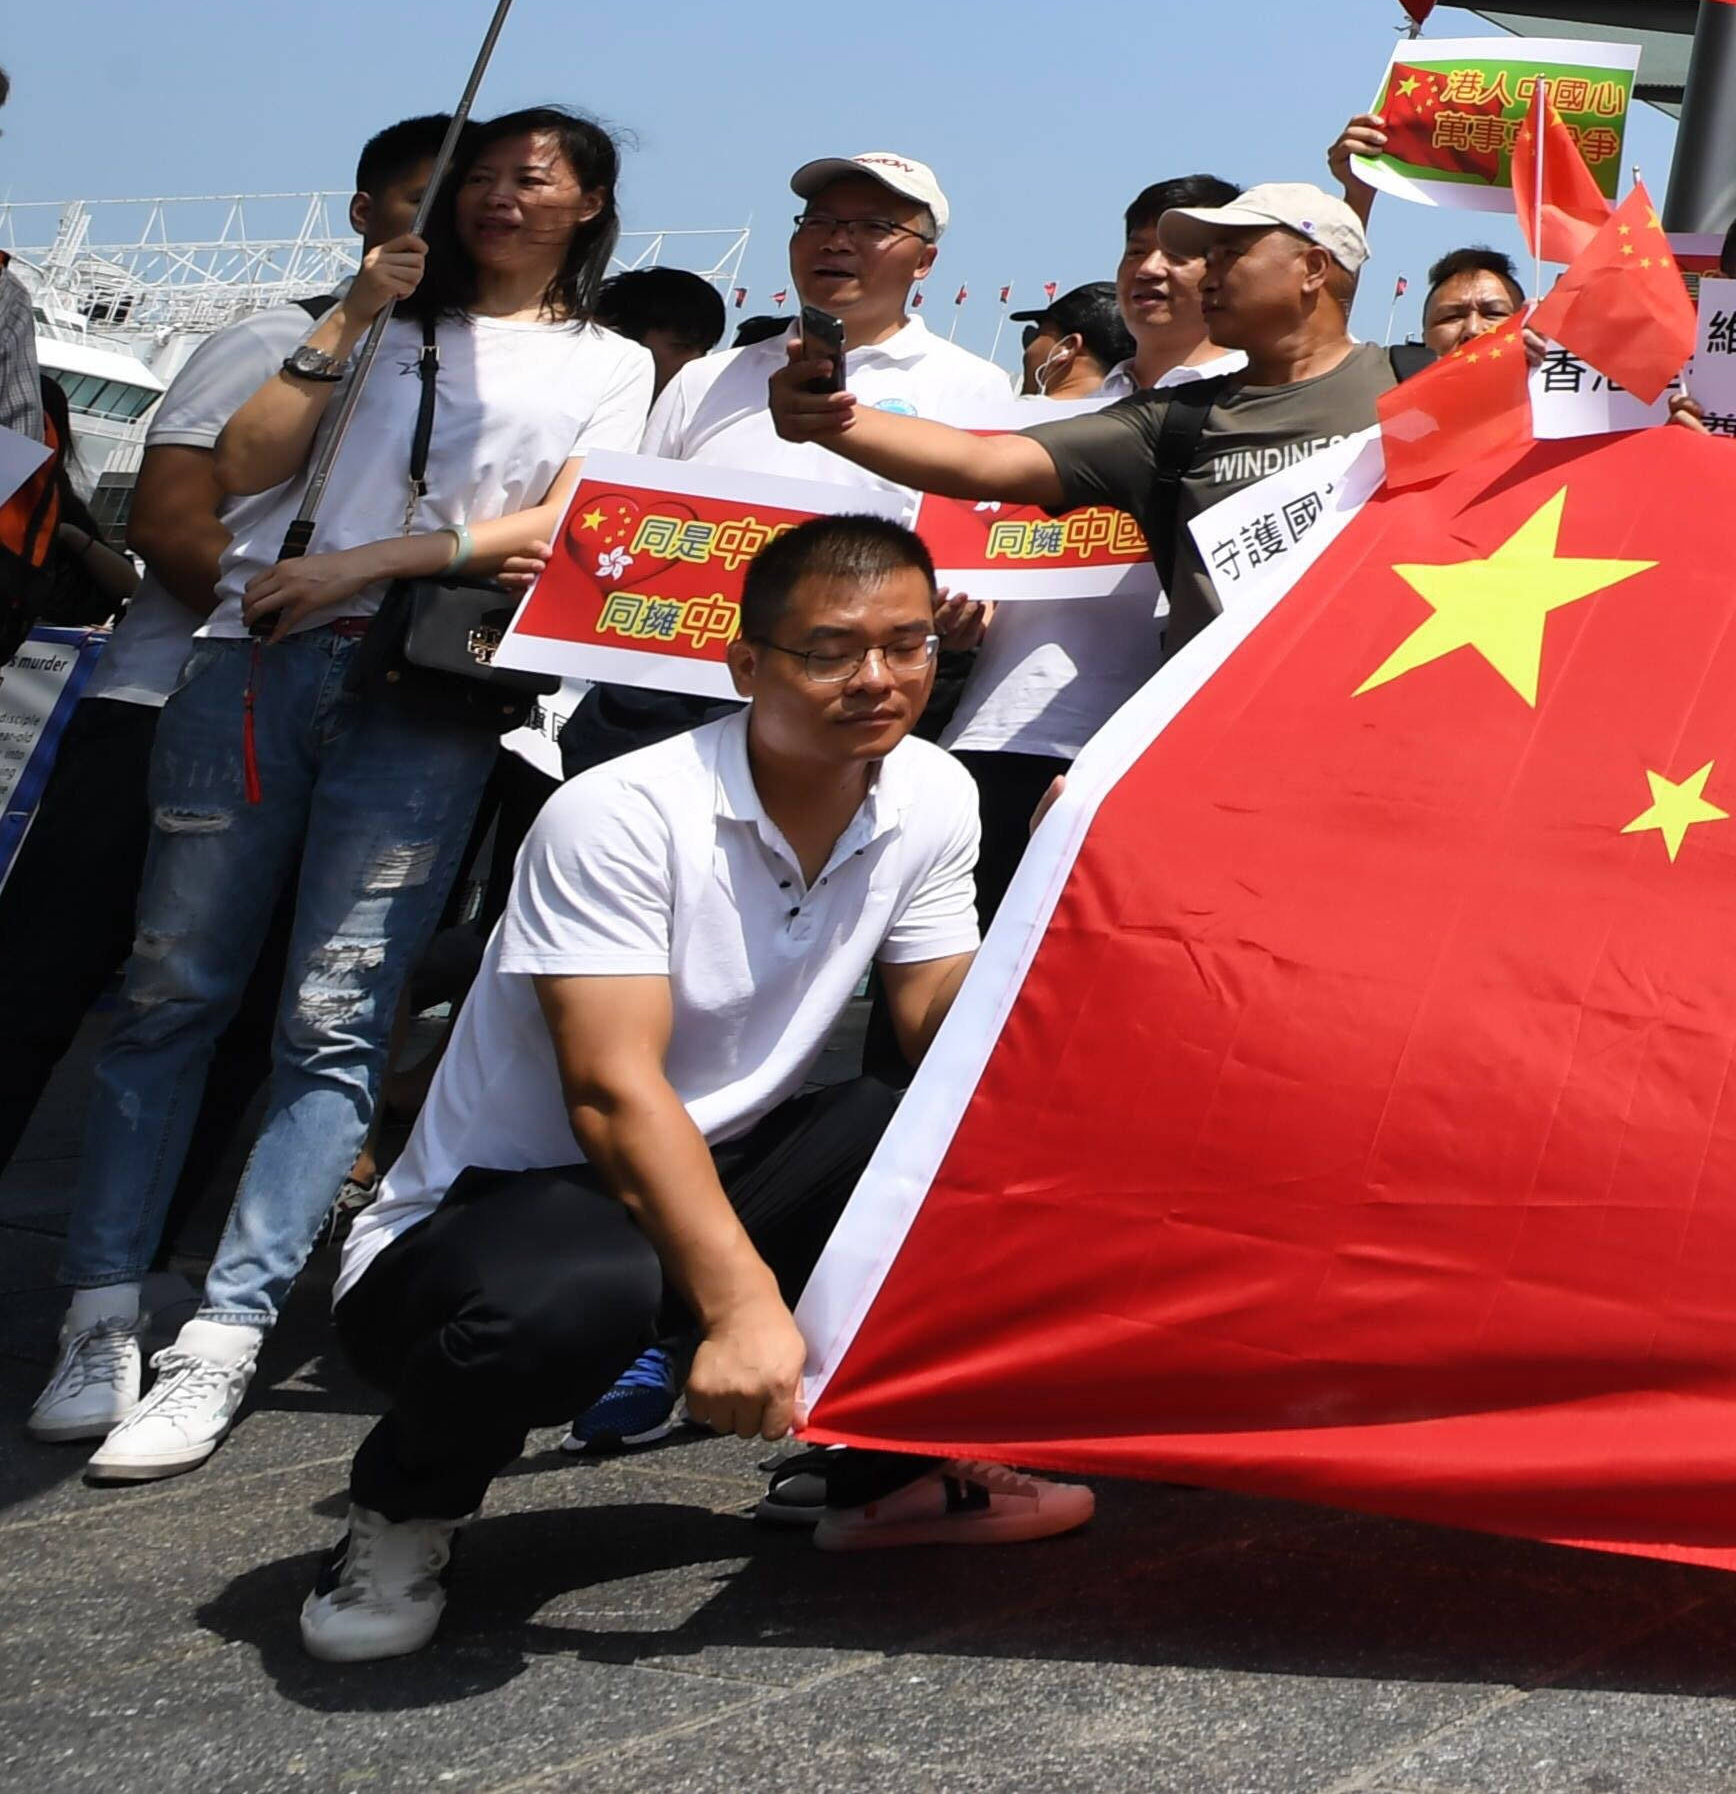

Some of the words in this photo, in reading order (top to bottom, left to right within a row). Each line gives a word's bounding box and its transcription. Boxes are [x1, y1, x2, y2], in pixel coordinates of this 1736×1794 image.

[629, 513, 798, 571] 同是中
[1211, 482, 1334, 581] 守護國
[596, 591, 740, 649] 同擁中
[18, 655, 68, 672] murder
